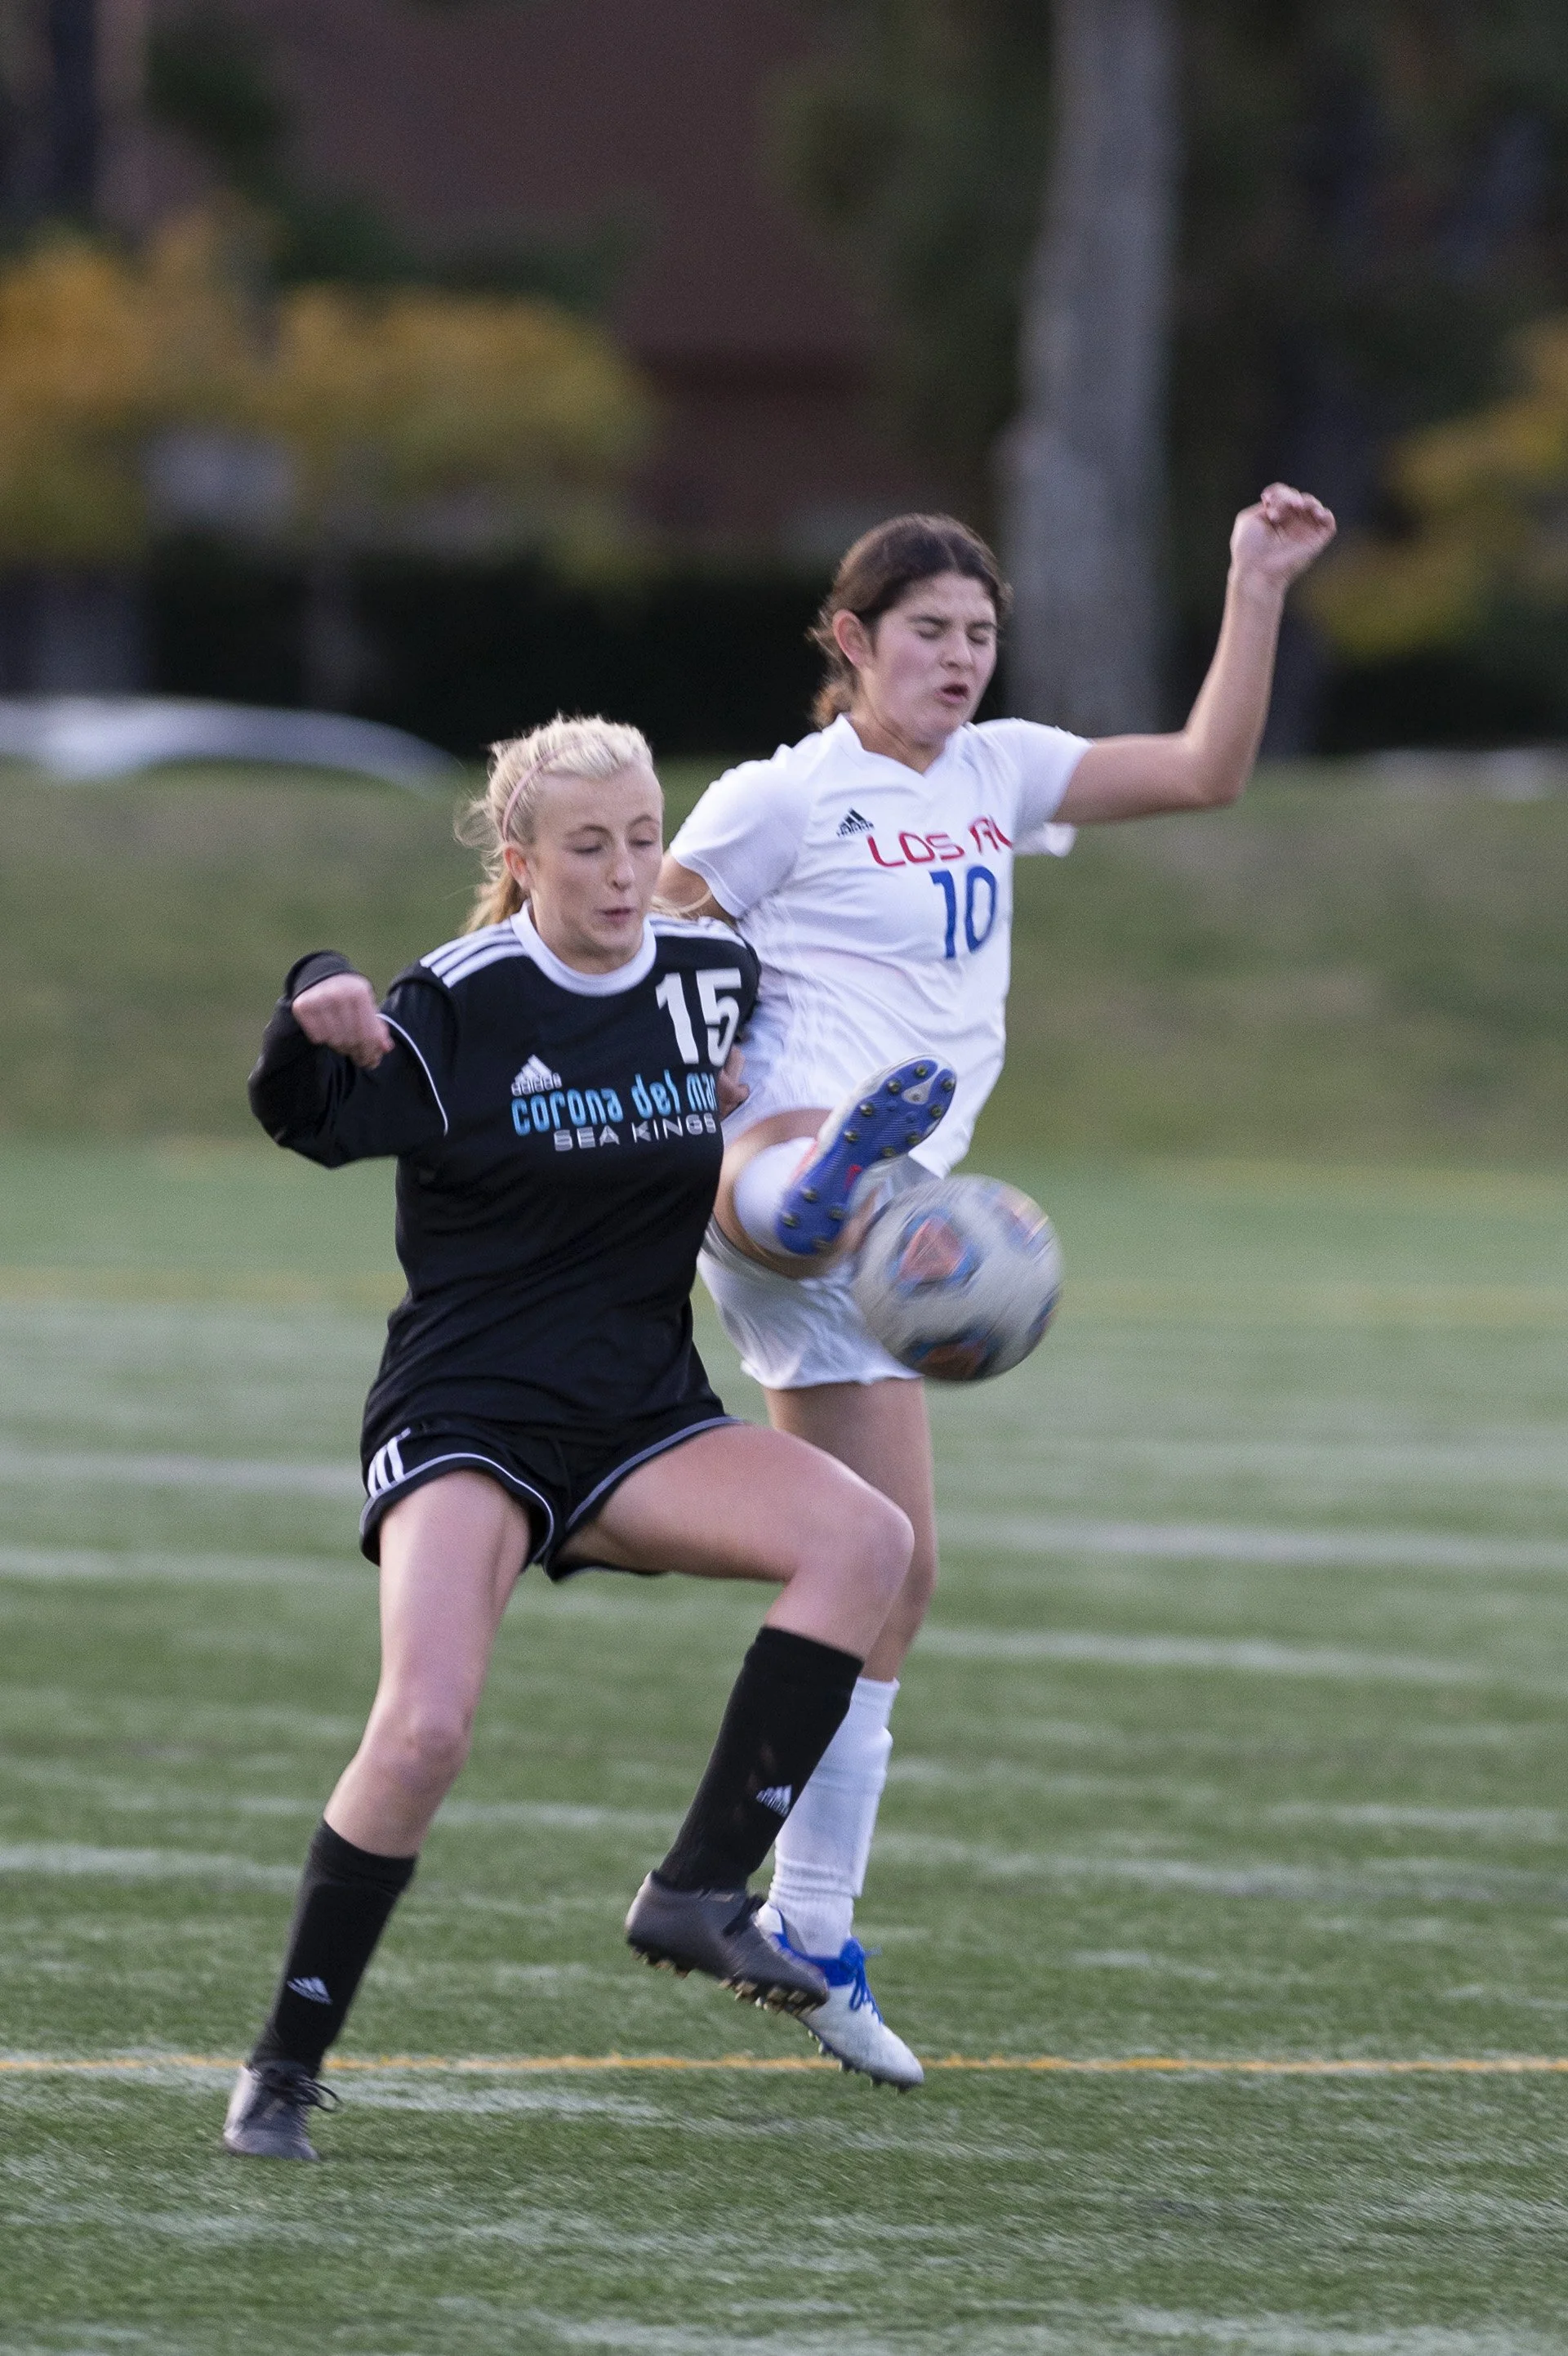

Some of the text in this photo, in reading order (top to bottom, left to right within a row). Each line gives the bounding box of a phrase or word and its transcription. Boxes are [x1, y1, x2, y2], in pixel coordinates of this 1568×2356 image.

[866, 831, 964, 868] LOS
[929, 865, 997, 959] 10
[655, 968, 742, 1067] 15
[511, 1088, 623, 1136] corona
[631, 1069, 681, 1120] del
[554, 1112, 717, 1152] SEA KINGS
